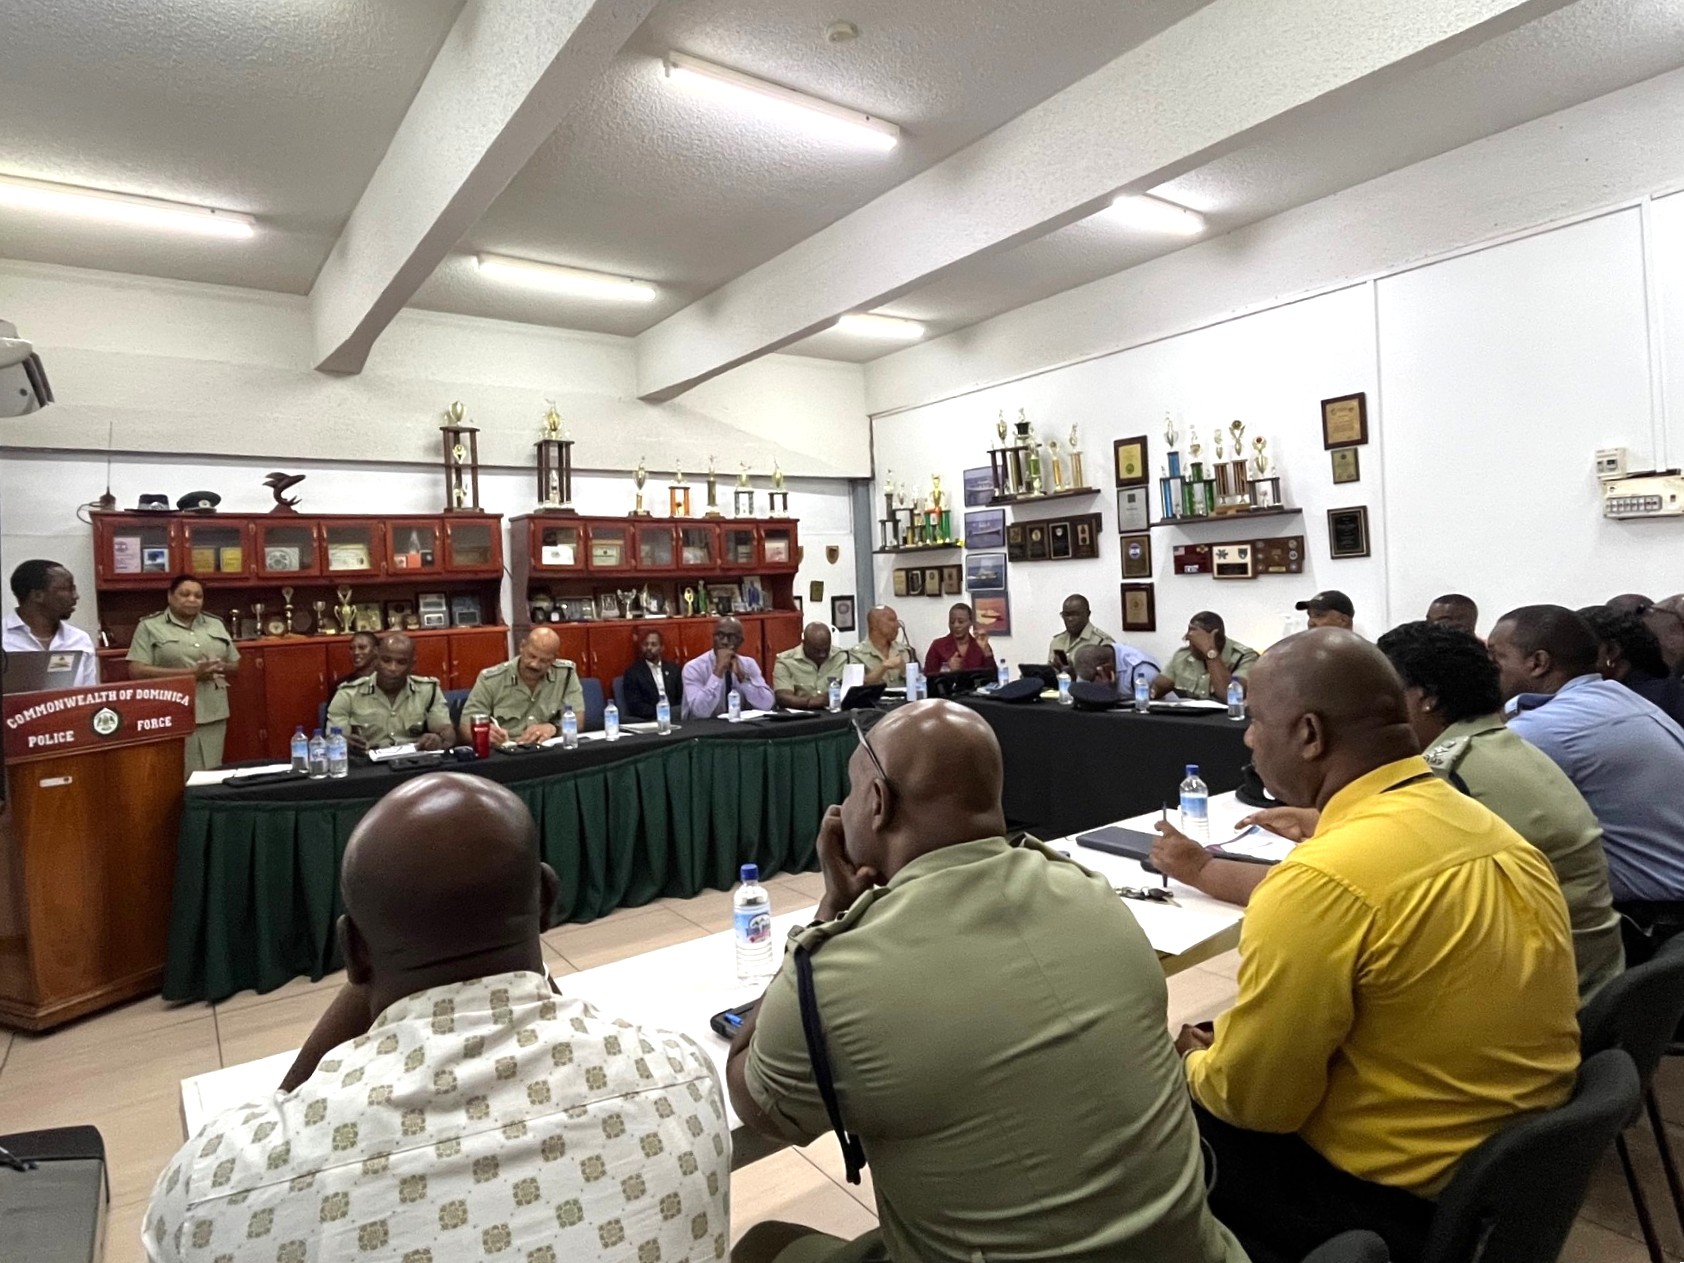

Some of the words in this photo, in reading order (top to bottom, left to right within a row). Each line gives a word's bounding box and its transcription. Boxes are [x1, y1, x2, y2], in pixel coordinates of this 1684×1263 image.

[7, 691, 117, 729] COMMONWEALTH
[119, 689, 133, 700] OF
[136, 689, 190, 706] DOMINICA
[28, 730, 75, 748] POLICE
[137, 716, 172, 731] FORCE
